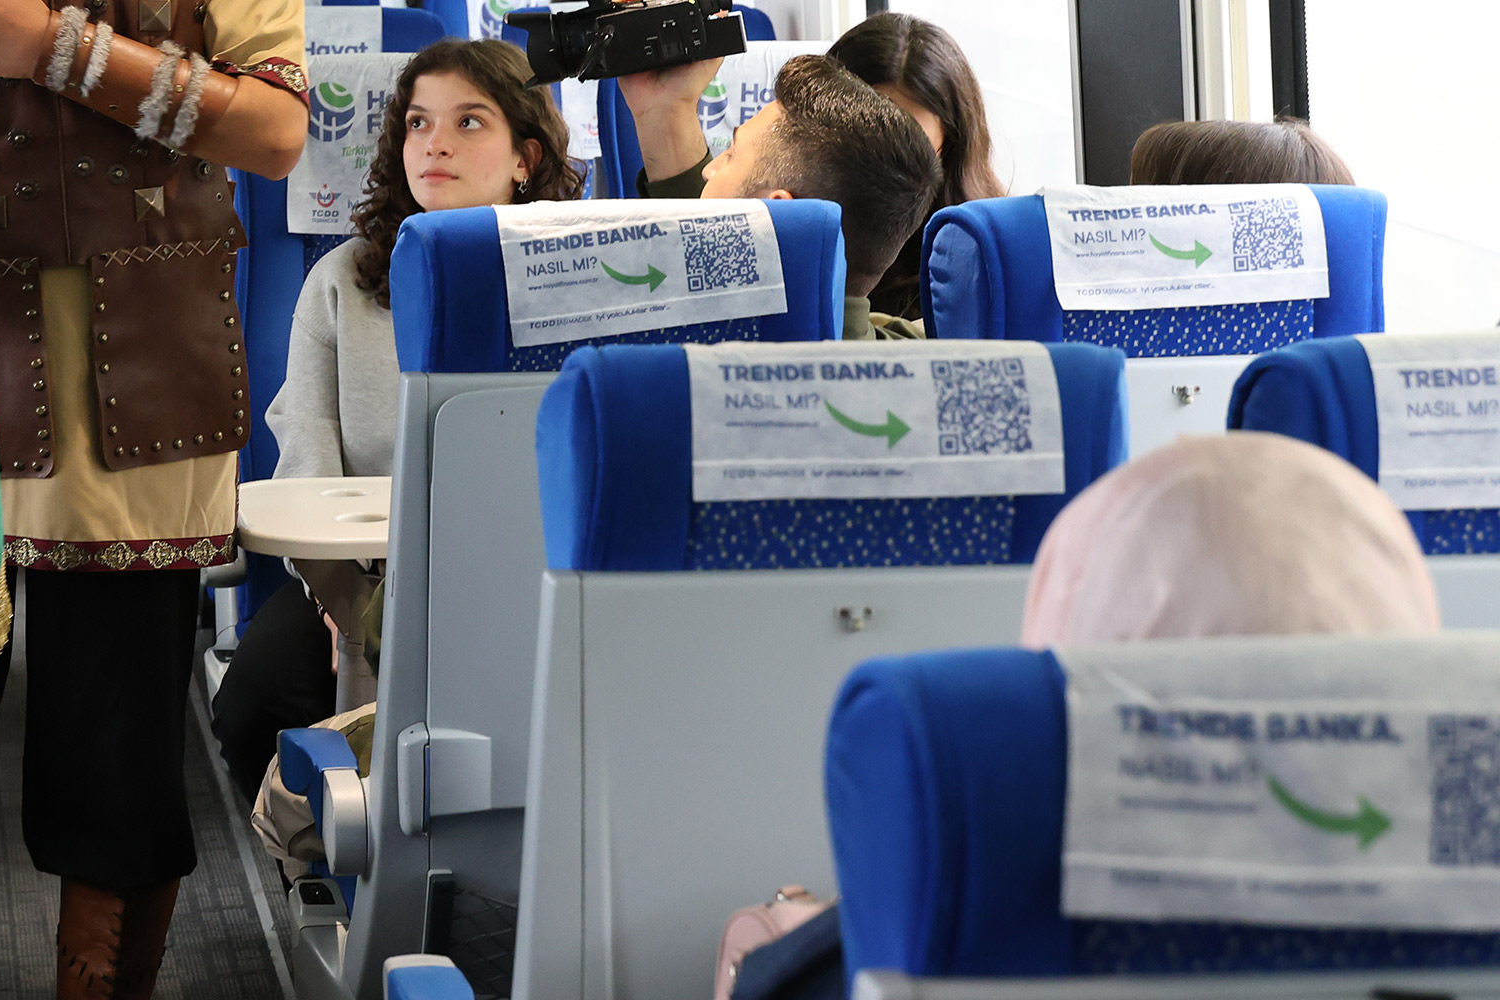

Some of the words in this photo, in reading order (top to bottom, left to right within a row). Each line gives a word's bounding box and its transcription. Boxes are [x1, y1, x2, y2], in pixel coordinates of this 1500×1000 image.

[1068, 206, 1143, 223] TRENDE
[1146, 203, 1216, 218] BANKA.
[520, 231, 594, 257] TRENDE
[597, 222, 667, 246] BANKA.
[1074, 230, 1118, 244] NASIL
[1121, 229, 1146, 243] MI?
[526, 260, 569, 278] NASIL
[573, 256, 598, 272] MI?
[719, 363, 815, 382] TRENDE
[819, 363, 915, 381] BANKA.
[1398, 366, 1498, 389] TRENDE
[724, 393, 782, 410] NASIL
[786, 392, 820, 410] MI?
[1406, 400, 1462, 418] NASIL
[1467, 399, 1499, 416] MI?
